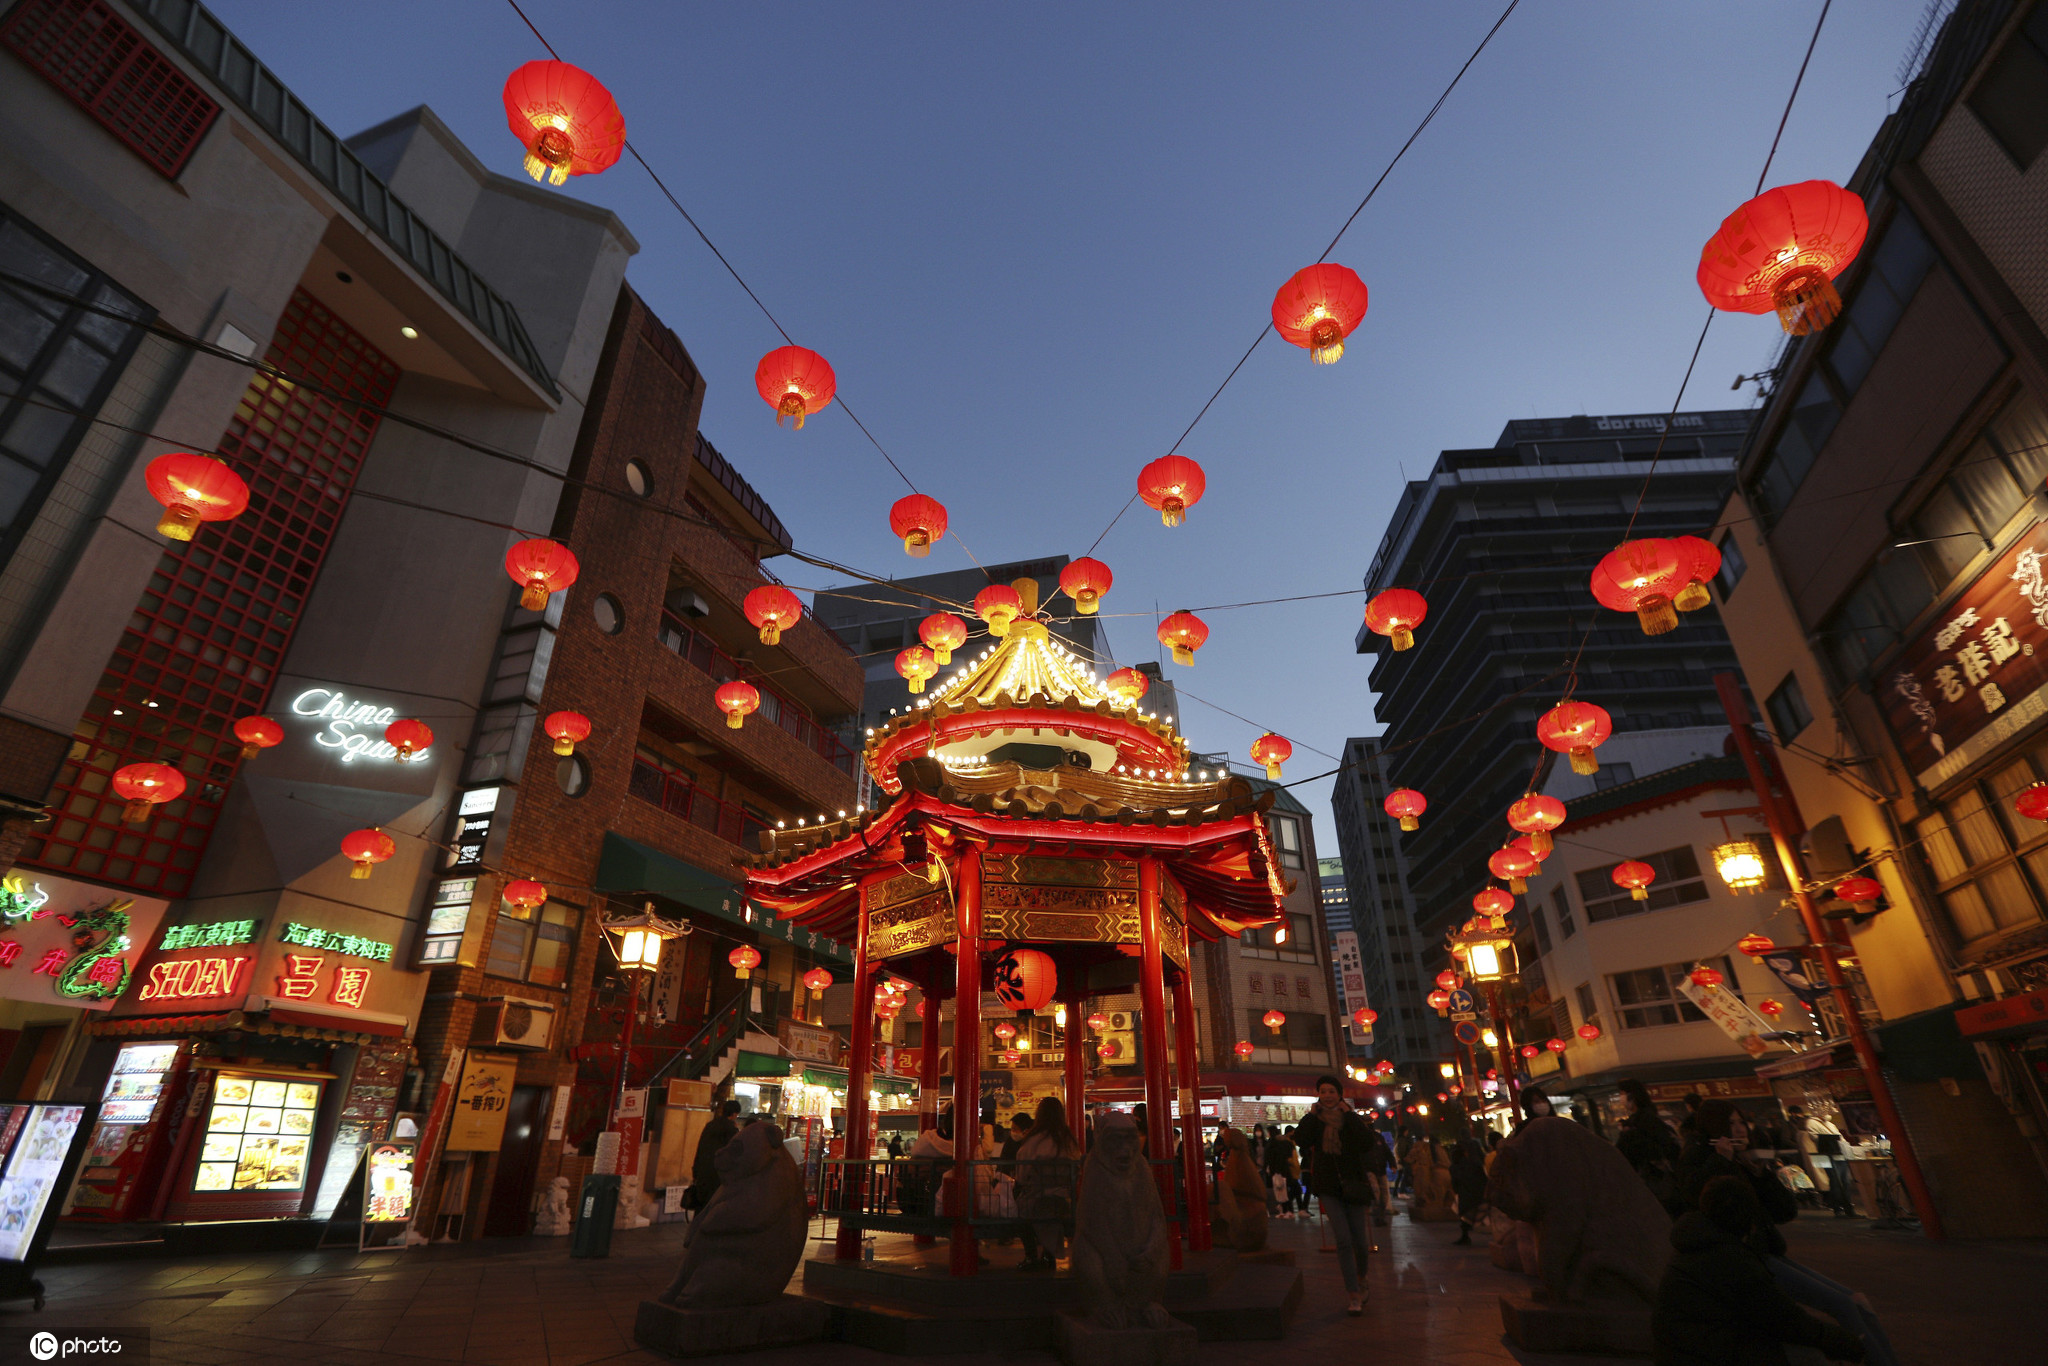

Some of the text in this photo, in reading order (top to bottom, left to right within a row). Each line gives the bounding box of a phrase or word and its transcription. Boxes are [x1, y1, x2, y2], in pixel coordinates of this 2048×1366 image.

[1597, 415, 1667, 433] dormy
[1934, 617, 2022, 704] 老祥記
[292, 688, 395, 725] China
[315, 719, 430, 762] Squae
[282, 922, 395, 963] 海鮮広東料理
[138, 956, 247, 1001] SHOEN
[282, 955, 373, 1009] 昌園
[460, 1095, 506, 1112] 一番搾り
